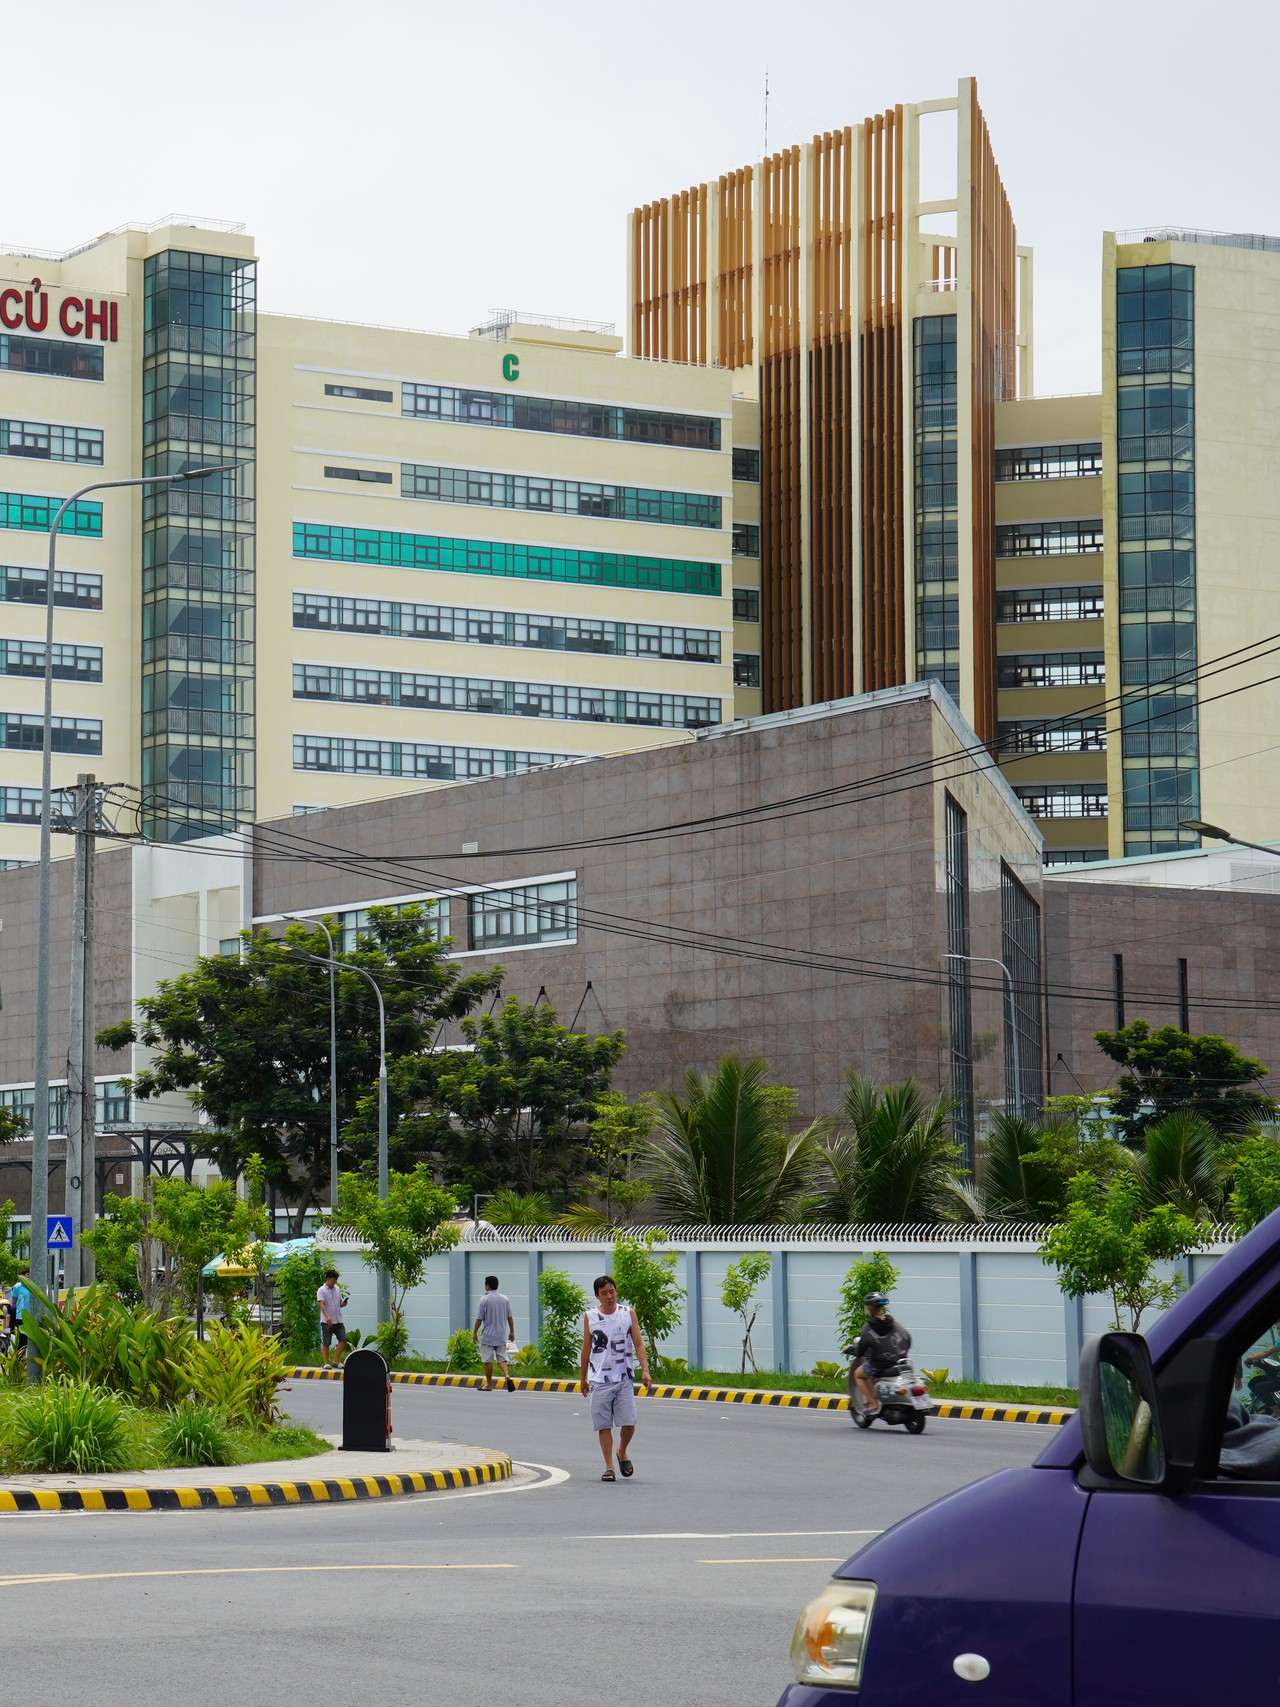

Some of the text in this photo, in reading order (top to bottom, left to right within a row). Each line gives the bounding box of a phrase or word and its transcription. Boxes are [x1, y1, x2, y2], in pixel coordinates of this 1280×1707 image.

[0, 277, 48, 332] CỦ
[59, 296, 118, 342] CHI
[502, 353, 520, 382] C
